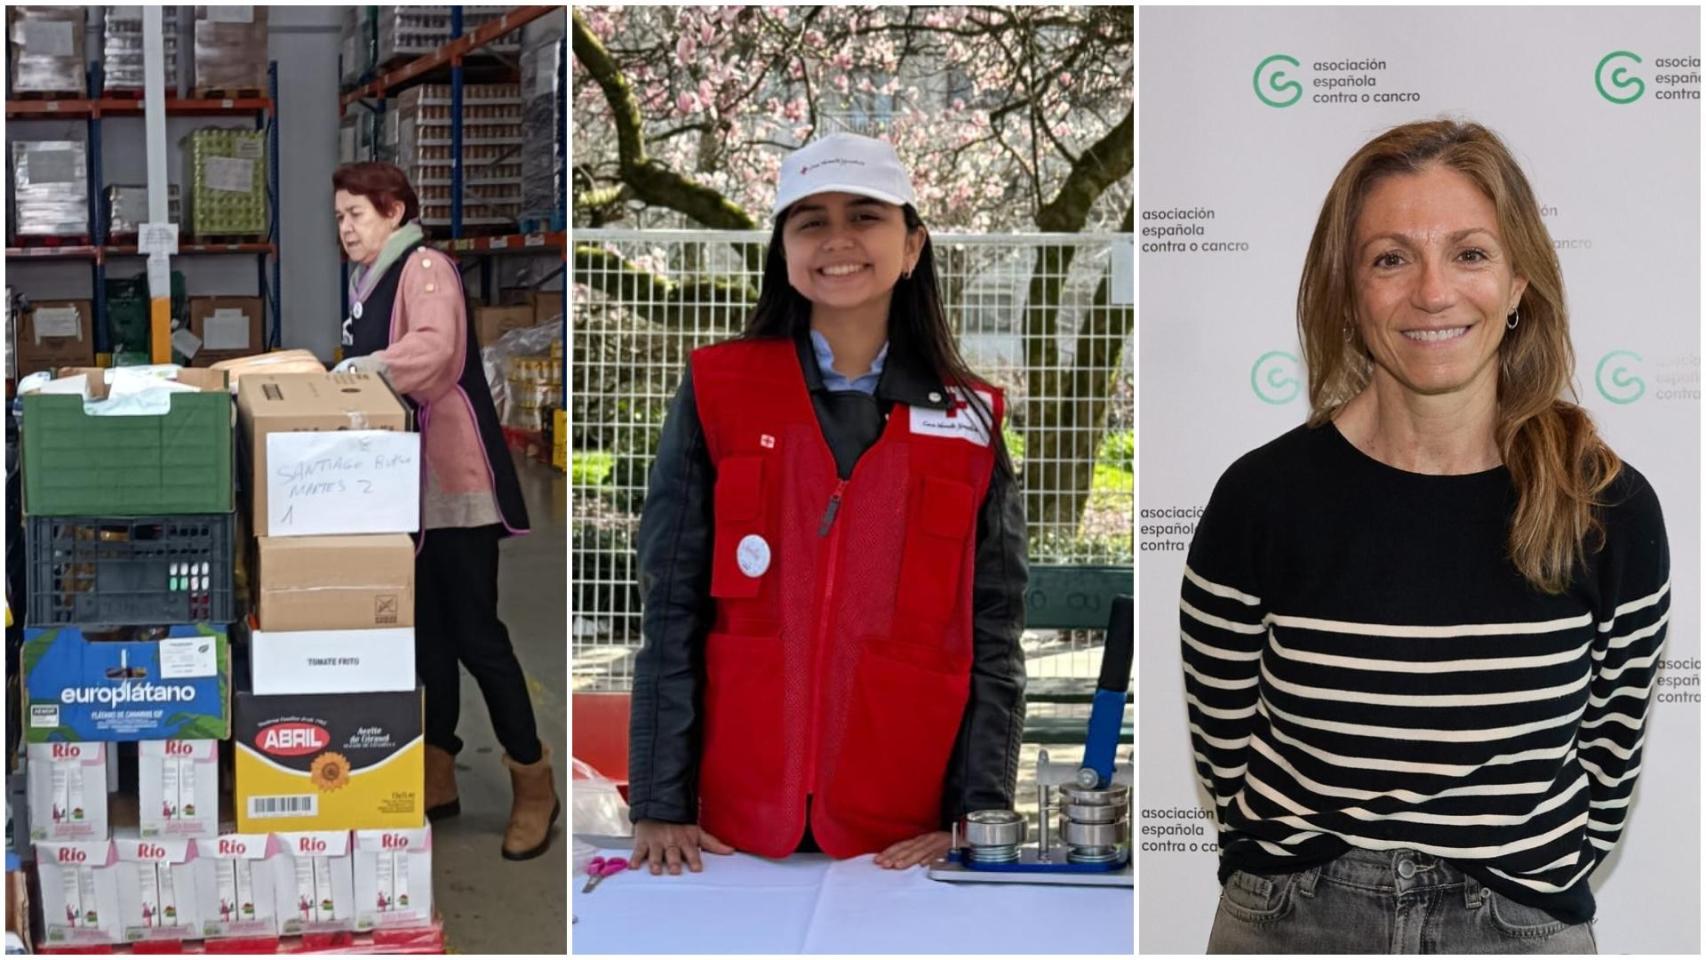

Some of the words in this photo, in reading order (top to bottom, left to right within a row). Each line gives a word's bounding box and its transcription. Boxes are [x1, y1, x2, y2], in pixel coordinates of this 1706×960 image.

[1312, 59, 1387, 71] asociación
[1312, 75, 1376, 90] española
[1312, 92, 1358, 103] contra
[1361, 93, 1370, 103] o
[1373, 92, 1421, 102] cancro
[1655, 88, 1701, 100] contra
[1142, 207, 1215, 220] asociación
[1142, 224, 1205, 239] española
[1142, 240, 1186, 252] contra
[1189, 242, 1198, 252] o
[1201, 241, 1249, 252] cancro
[1553, 239, 1593, 249] ancro
[1140, 506, 1205, 519] asociació
[1140, 522, 1196, 538] español
[1140, 539, 1185, 551] contra
[308, 657, 336, 666] TOMATE
[338, 657, 360, 665] FRITO
[61, 678, 195, 709] europlátano
[264, 728, 322, 749] ABRIL
[1141, 807, 1214, 819] asociación
[1141, 823, 1204, 838] española
[1141, 840, 1186, 852] contra
[1189, 842, 1198, 852] o
